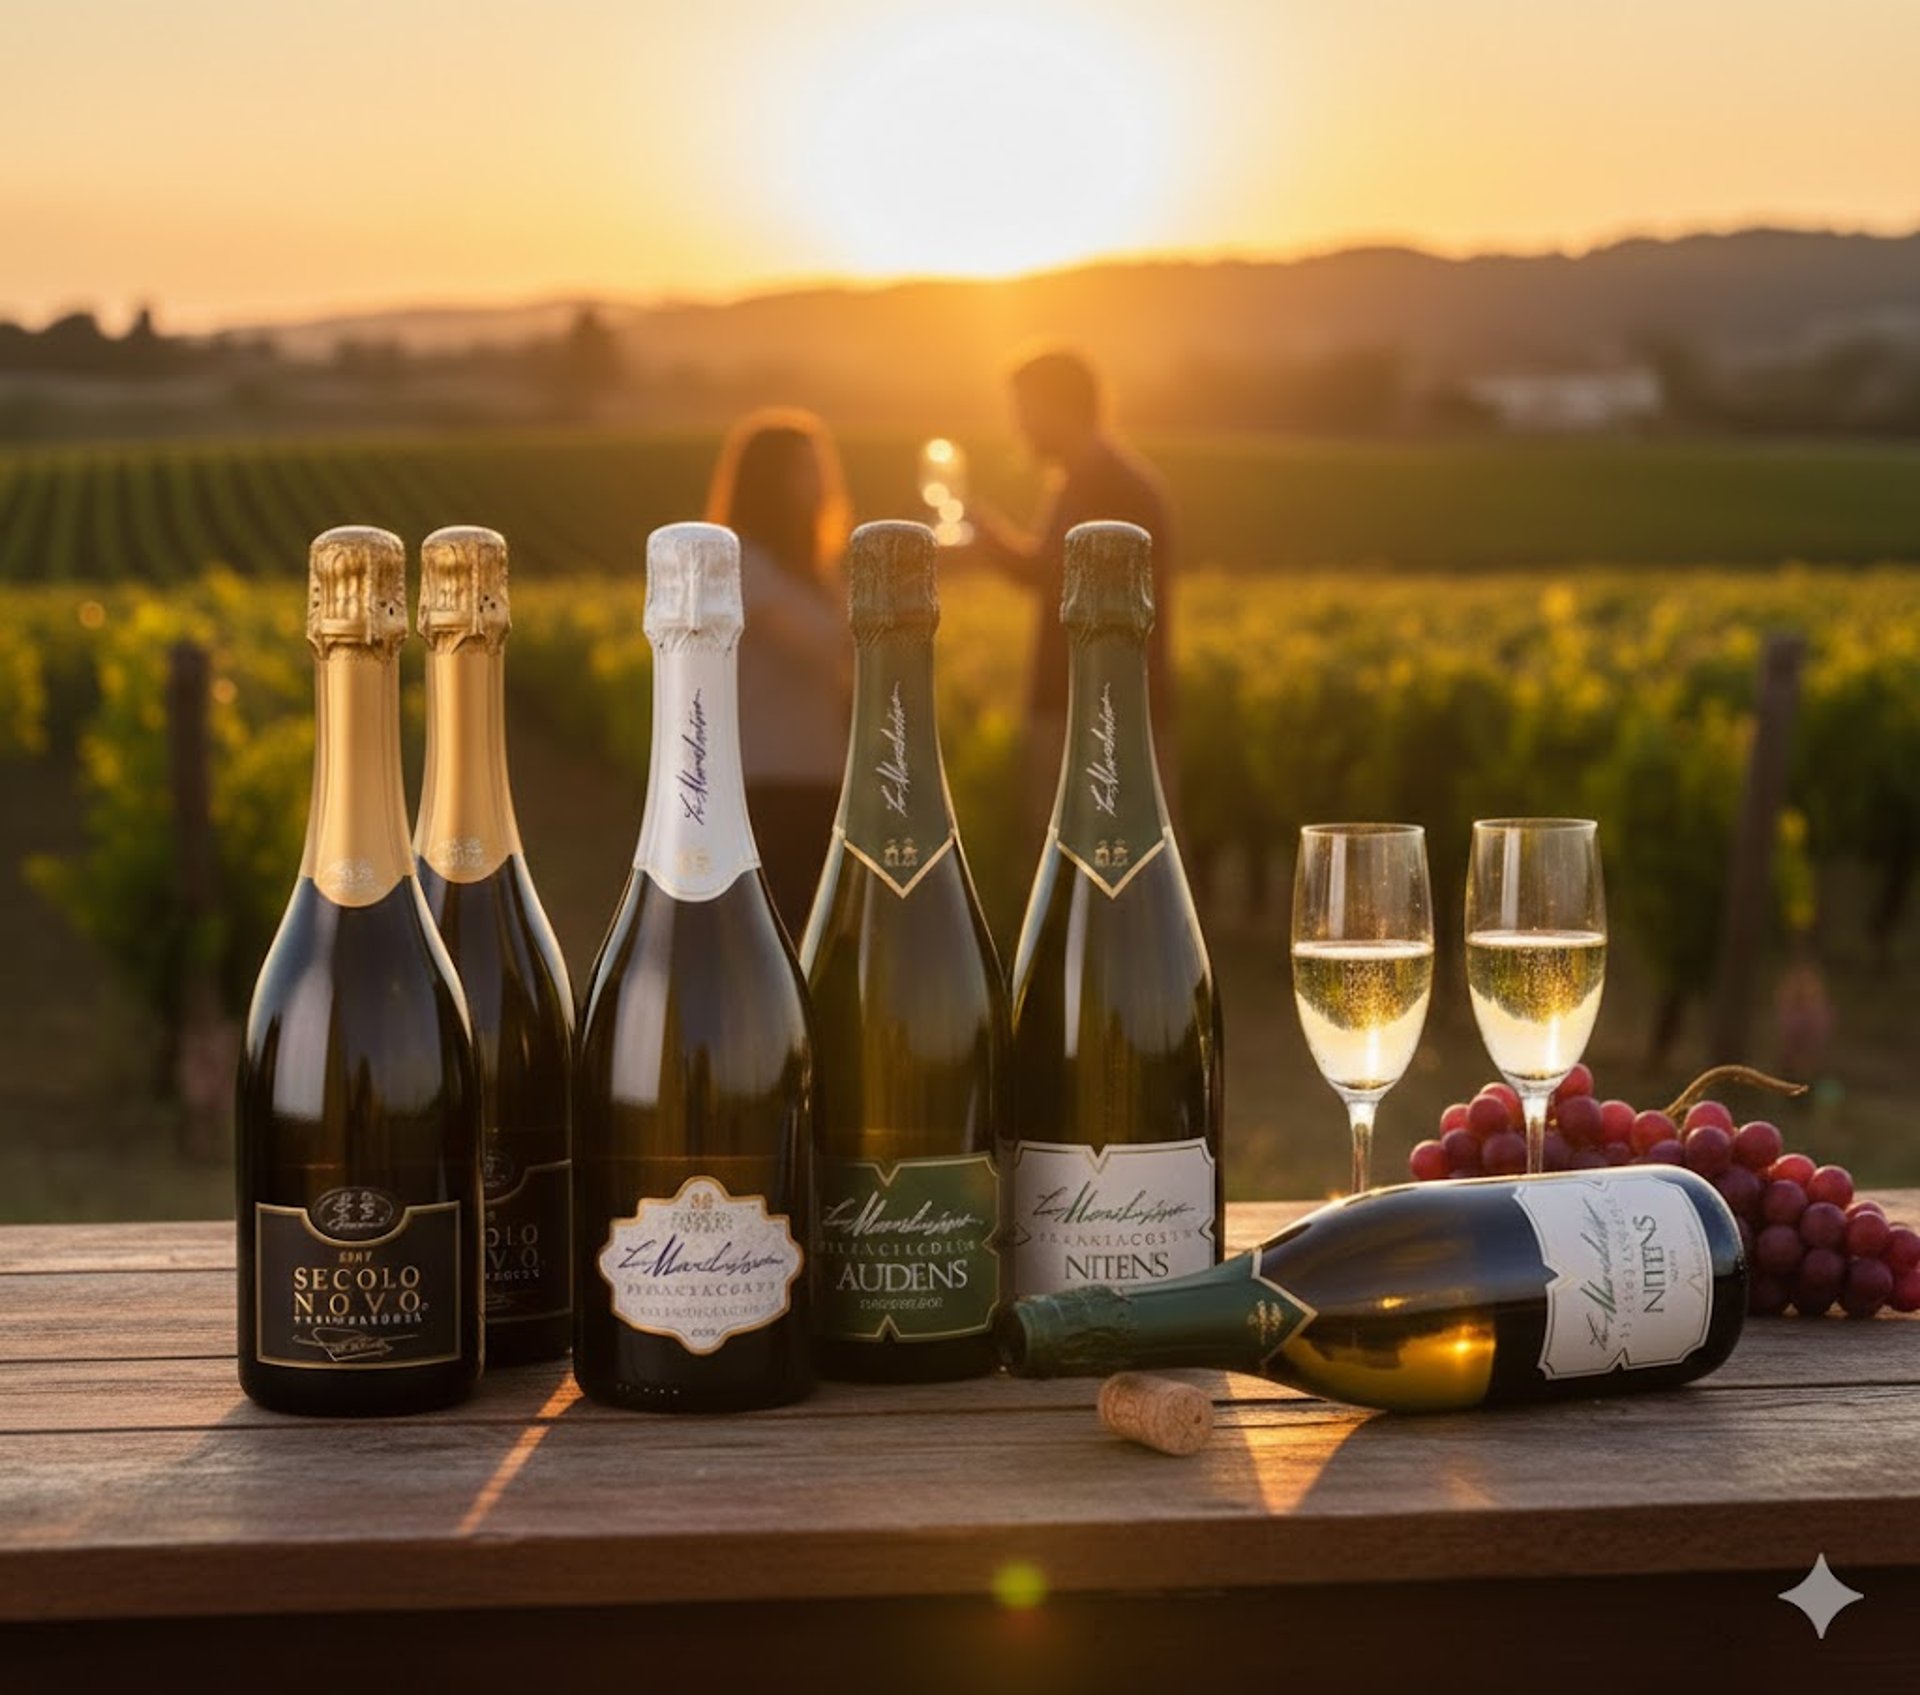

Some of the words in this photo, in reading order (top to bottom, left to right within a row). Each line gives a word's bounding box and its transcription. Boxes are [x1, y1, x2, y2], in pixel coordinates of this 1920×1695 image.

[293, 1265, 421, 1291] SECOLO
[835, 1259, 969, 1293] AUDENS
[1064, 1251, 1170, 1280] NITENS
[1632, 1214, 1667, 1314] NITENS
